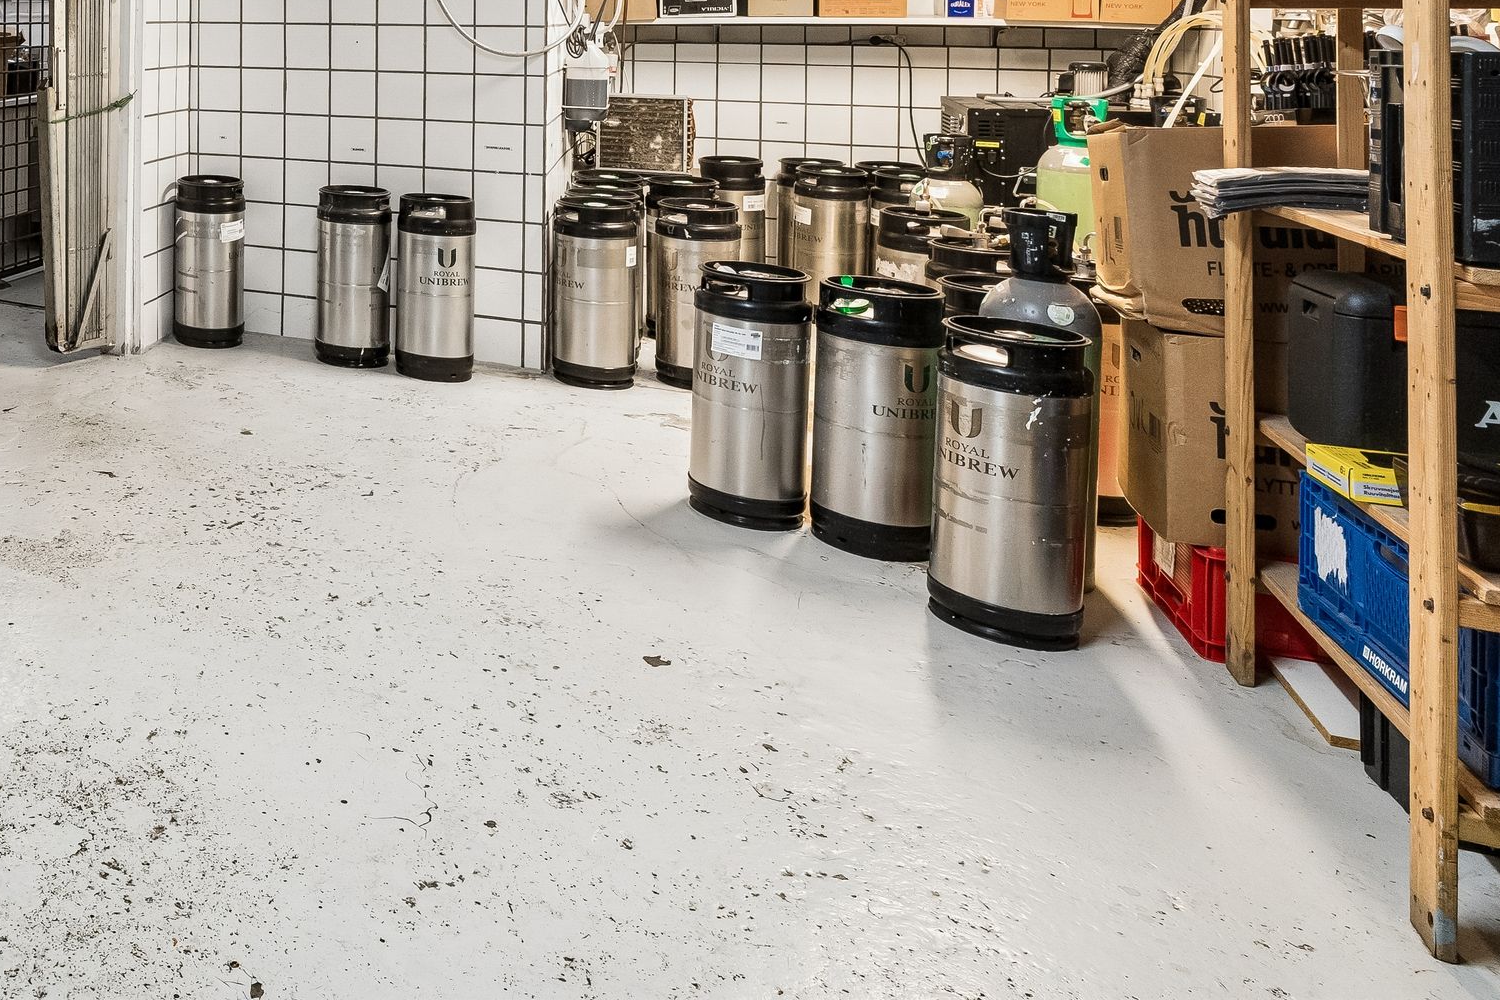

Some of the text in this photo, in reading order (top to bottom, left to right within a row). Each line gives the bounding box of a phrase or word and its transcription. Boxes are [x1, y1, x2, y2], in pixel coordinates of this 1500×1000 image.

[419, 276, 470, 288] UNIBREW
[433, 270, 461, 278] ROYAL
[701, 361, 736, 378] ROYAL
[697, 370, 759, 394] NIBREW
[897, 397, 934, 407] ROYAL
[945, 436, 990, 459] ROYAL
[939, 446, 1020, 481] NIBREW
[1368, 650, 1408, 695] HØRKRAM
